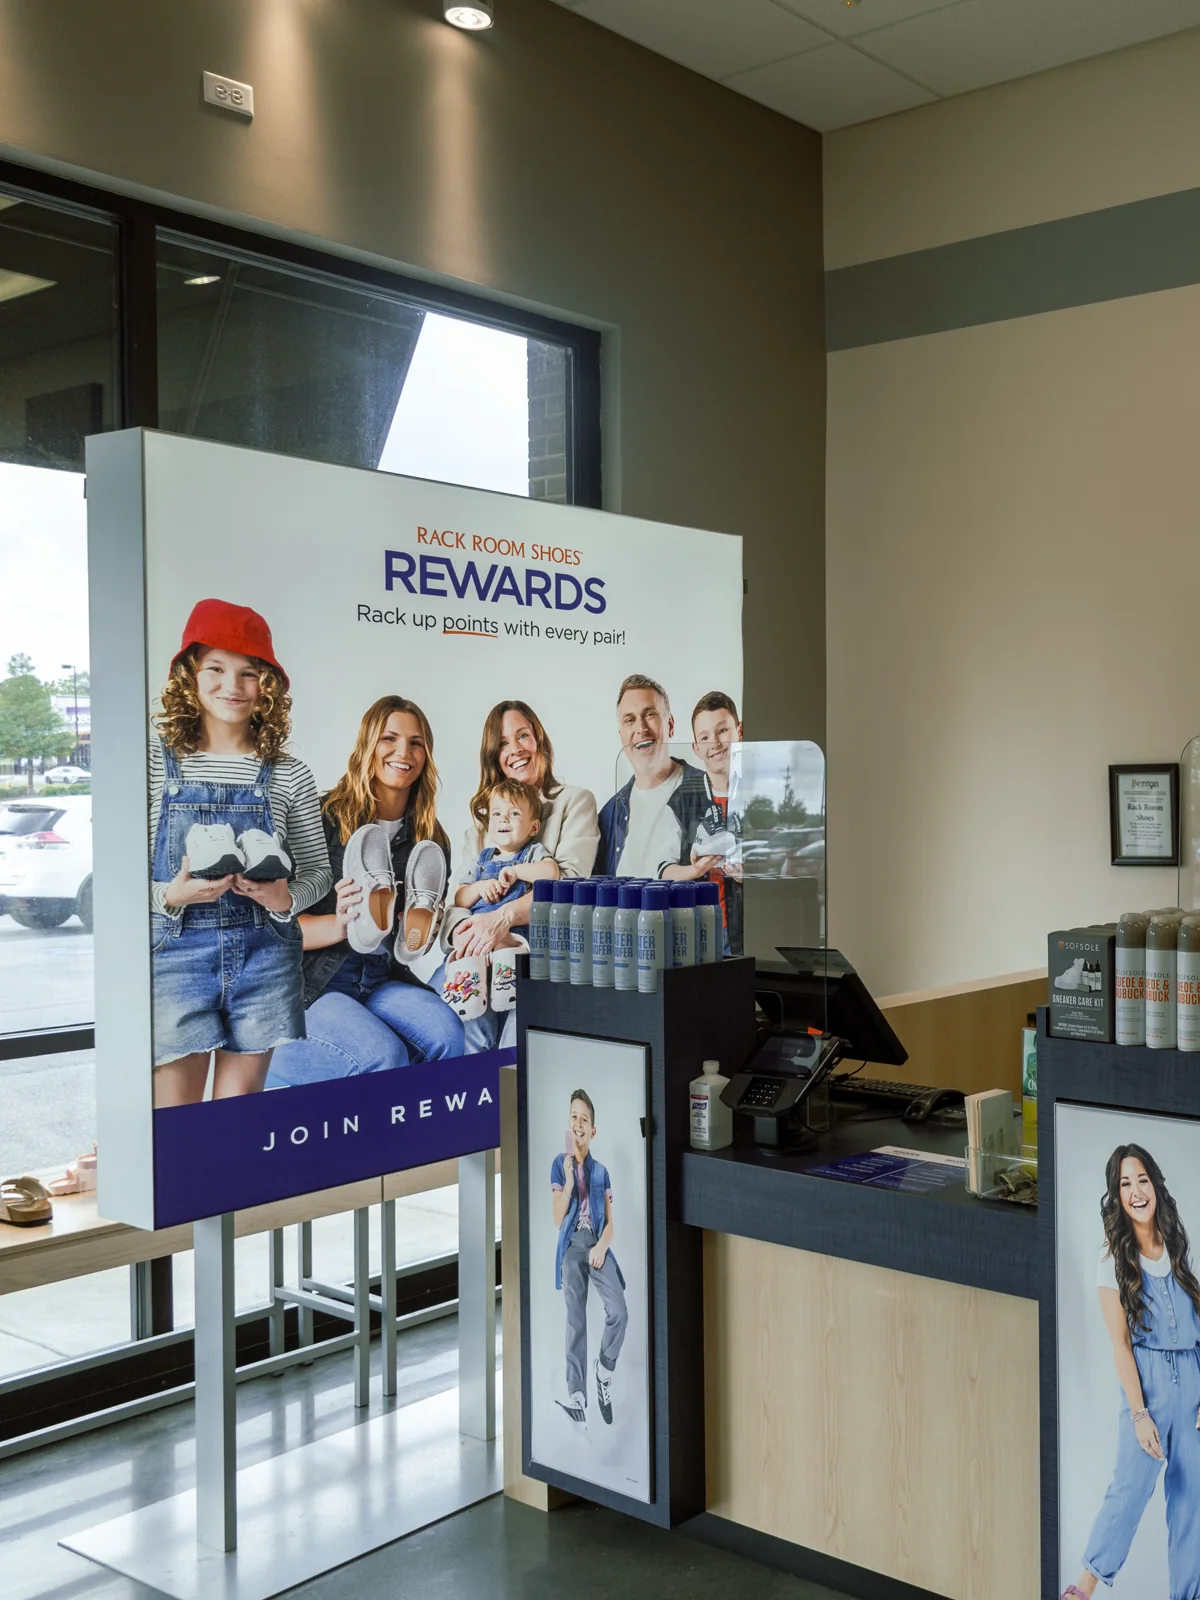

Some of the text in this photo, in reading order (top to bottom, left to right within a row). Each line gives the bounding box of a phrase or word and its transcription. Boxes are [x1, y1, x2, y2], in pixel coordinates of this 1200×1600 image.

[417, 526, 582, 566] RACK ROOM SHOES
[384, 549, 607, 615] REWARDS
[357, 604, 626, 646] Rack up points with every pair!
[1127, 803, 1164, 812] Rack Room
[1065, 942, 1100, 952] SOFSOLE
[1138, 976, 1144, 988] &
[1163, 979, 1169, 991] &
[1052, 994, 1077, 1006] SNEAKER
[1077, 996, 1093, 1007] CARE
[1094, 998, 1104, 1008] KIT
[262, 1114, 359, 1152] JOIN
